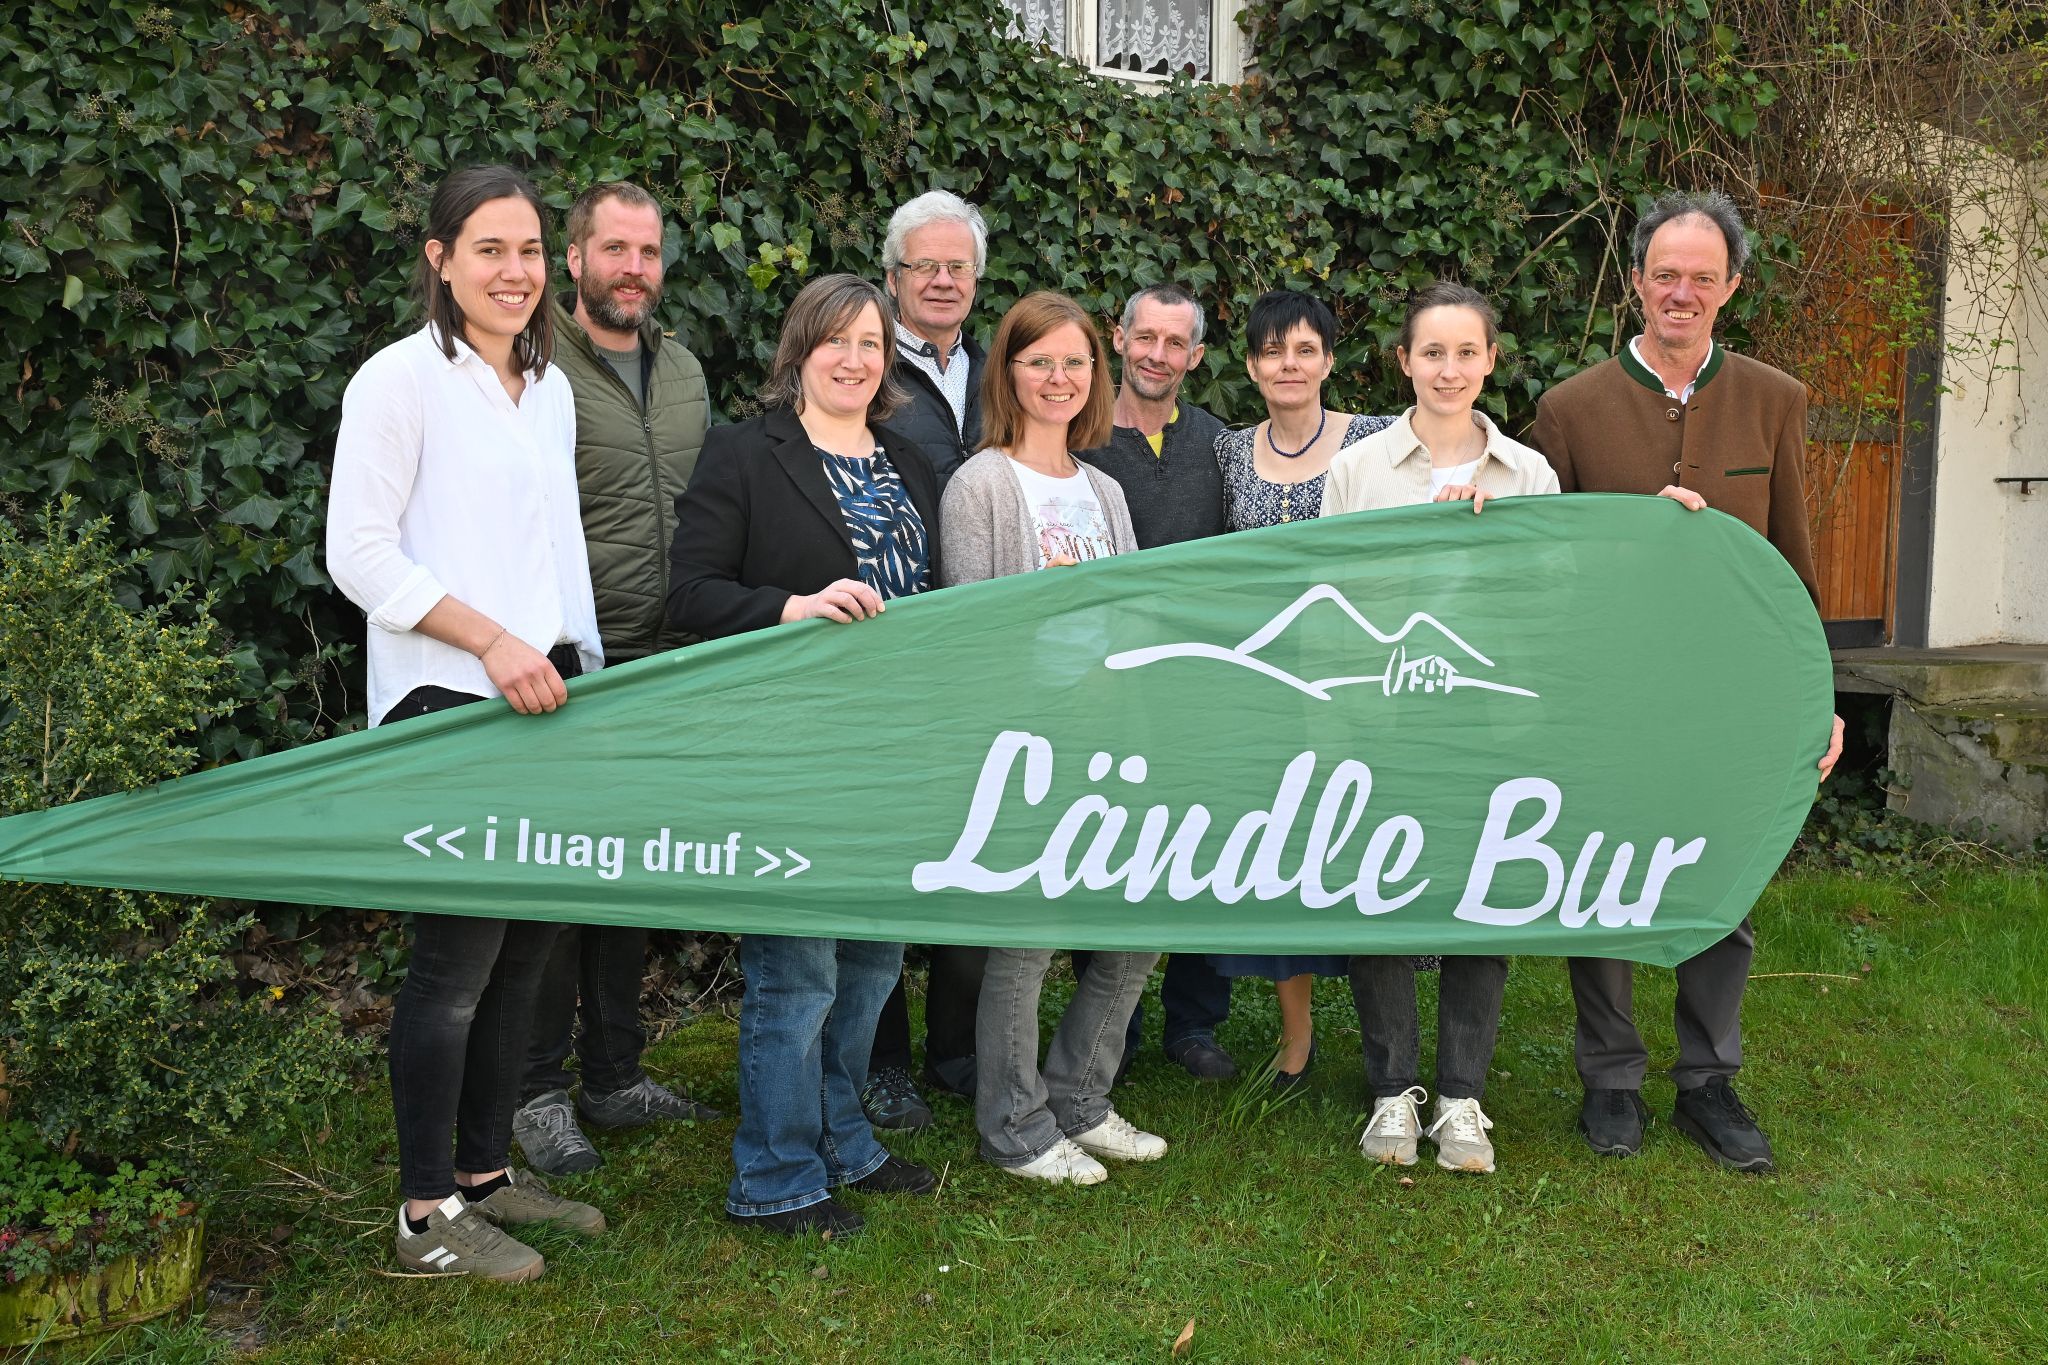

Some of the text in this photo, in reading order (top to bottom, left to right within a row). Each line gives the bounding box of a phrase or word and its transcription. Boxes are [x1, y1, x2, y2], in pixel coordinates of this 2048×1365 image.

[484, 815, 498, 862] i
[516, 817, 625, 881] luag
[642, 827, 742, 876] druf
[911, 729, 1707, 929] Ländle Bur
